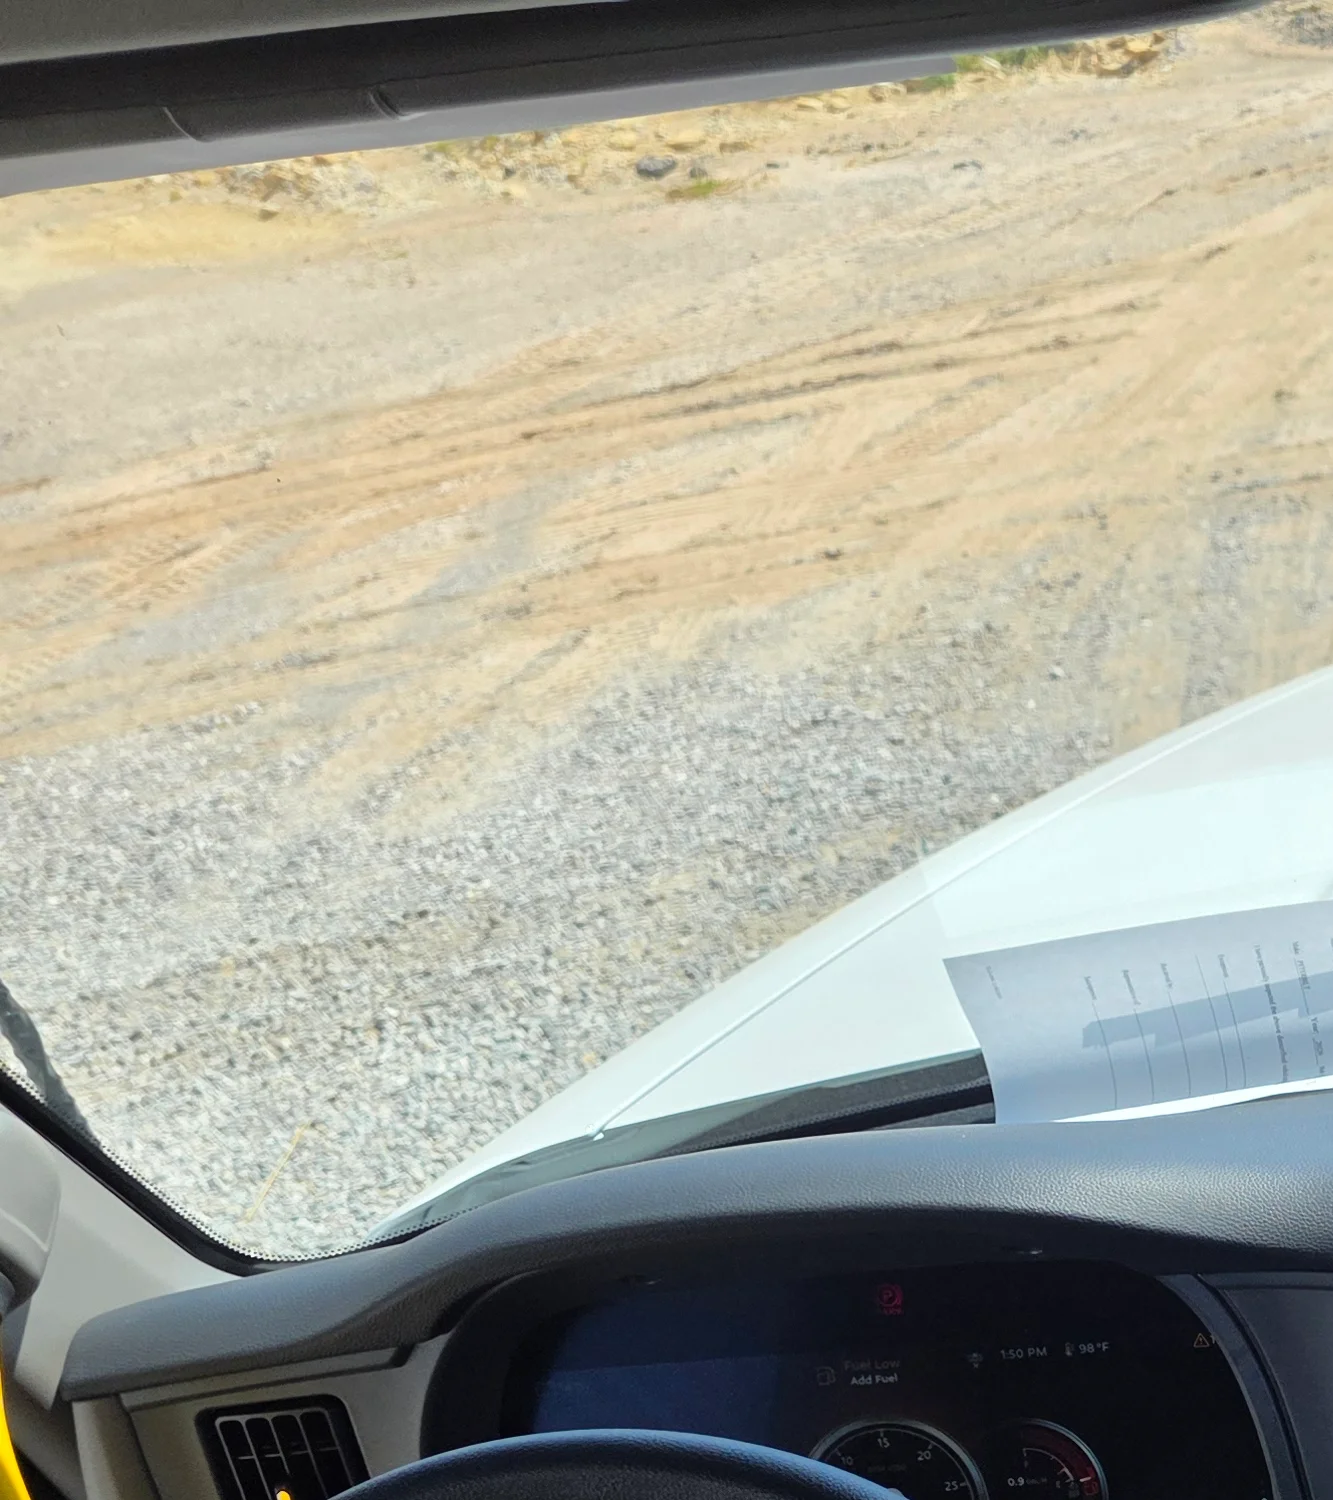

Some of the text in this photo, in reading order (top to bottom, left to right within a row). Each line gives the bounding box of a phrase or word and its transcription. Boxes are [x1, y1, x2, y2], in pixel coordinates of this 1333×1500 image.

[1000, 1347, 1047, 1360] 1:50 PM
[1078, 1343, 1094, 1354] 98
[843, 1360, 900, 1371] Fuel Low
[851, 1373, 898, 1386] Add Fuel
[877, 1438, 890, 1448] 15
[841, 1456, 854, 1466] 10
[917, 1450, 931, 1461] 20
[944, 1481, 959, 1491] 25
[1007, 1477, 1025, 1487] 0.9
